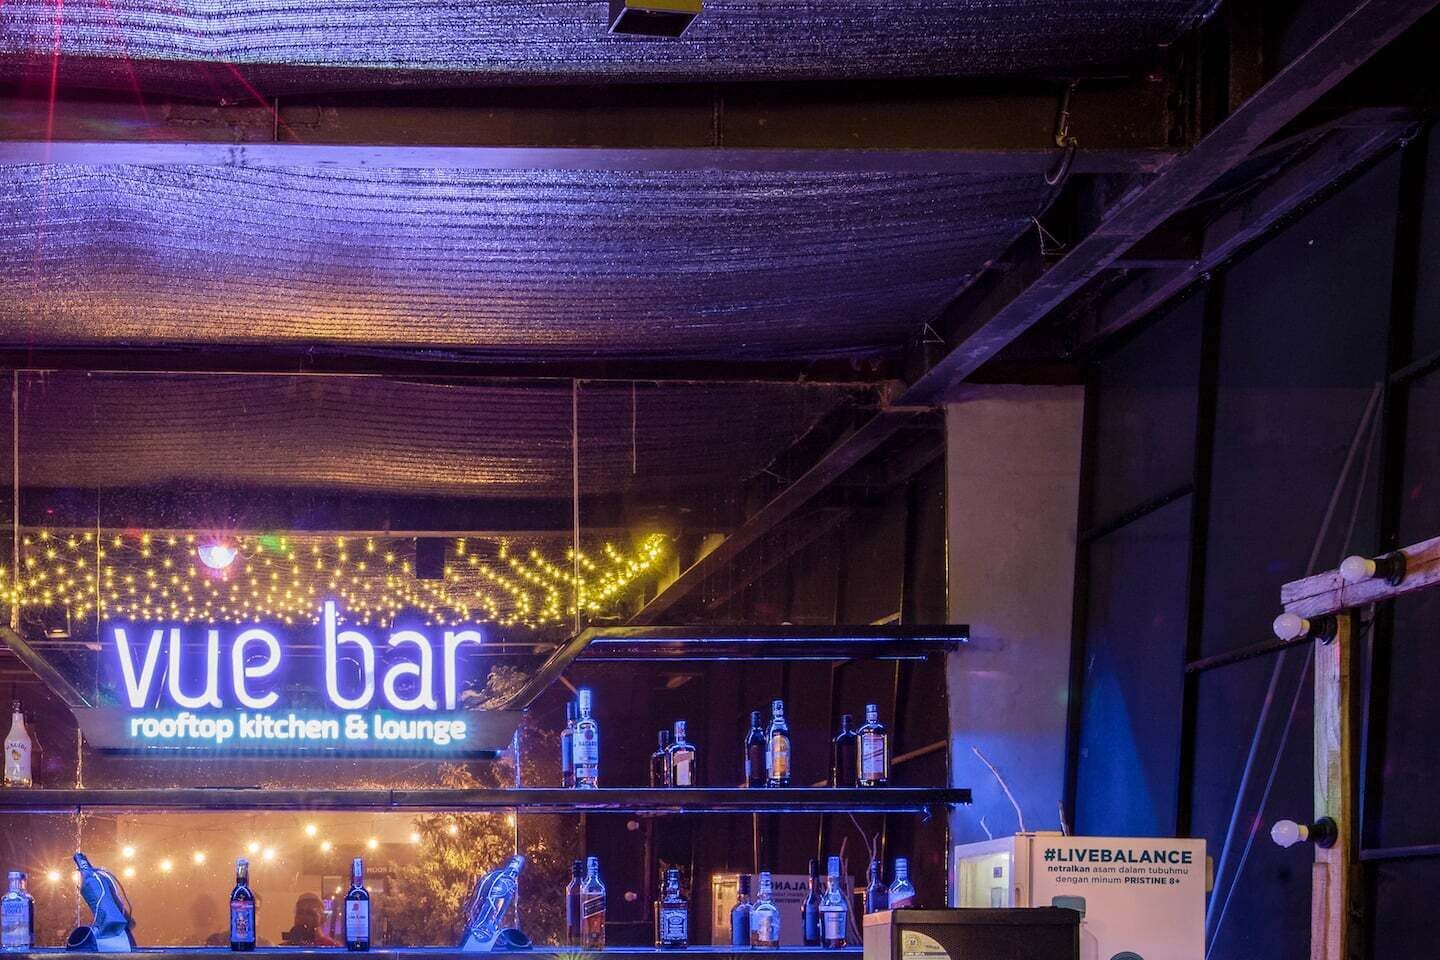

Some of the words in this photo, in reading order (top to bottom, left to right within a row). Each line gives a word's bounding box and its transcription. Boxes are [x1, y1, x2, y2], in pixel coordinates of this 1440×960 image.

[114, 627, 282, 710] vue
[323, 600, 482, 711] bar
[130, 712, 234, 744] rooftop
[239, 713, 339, 739] kitchen
[345, 713, 368, 740] &
[374, 714, 467, 745] lounge
[1044, 848, 1193, 865] #LIVEBALANCE
[1047, 864, 1090, 873] netralkan
[1118, 865, 1146, 874] dalam
[1149, 866, 1189, 875] tubuhmu
[1056, 875, 1089, 886] dengan
[1091, 875, 1122, 884] minum
[1124, 876, 1167, 885] PRISTINE
[1169, 877, 1180, 885] 8+
